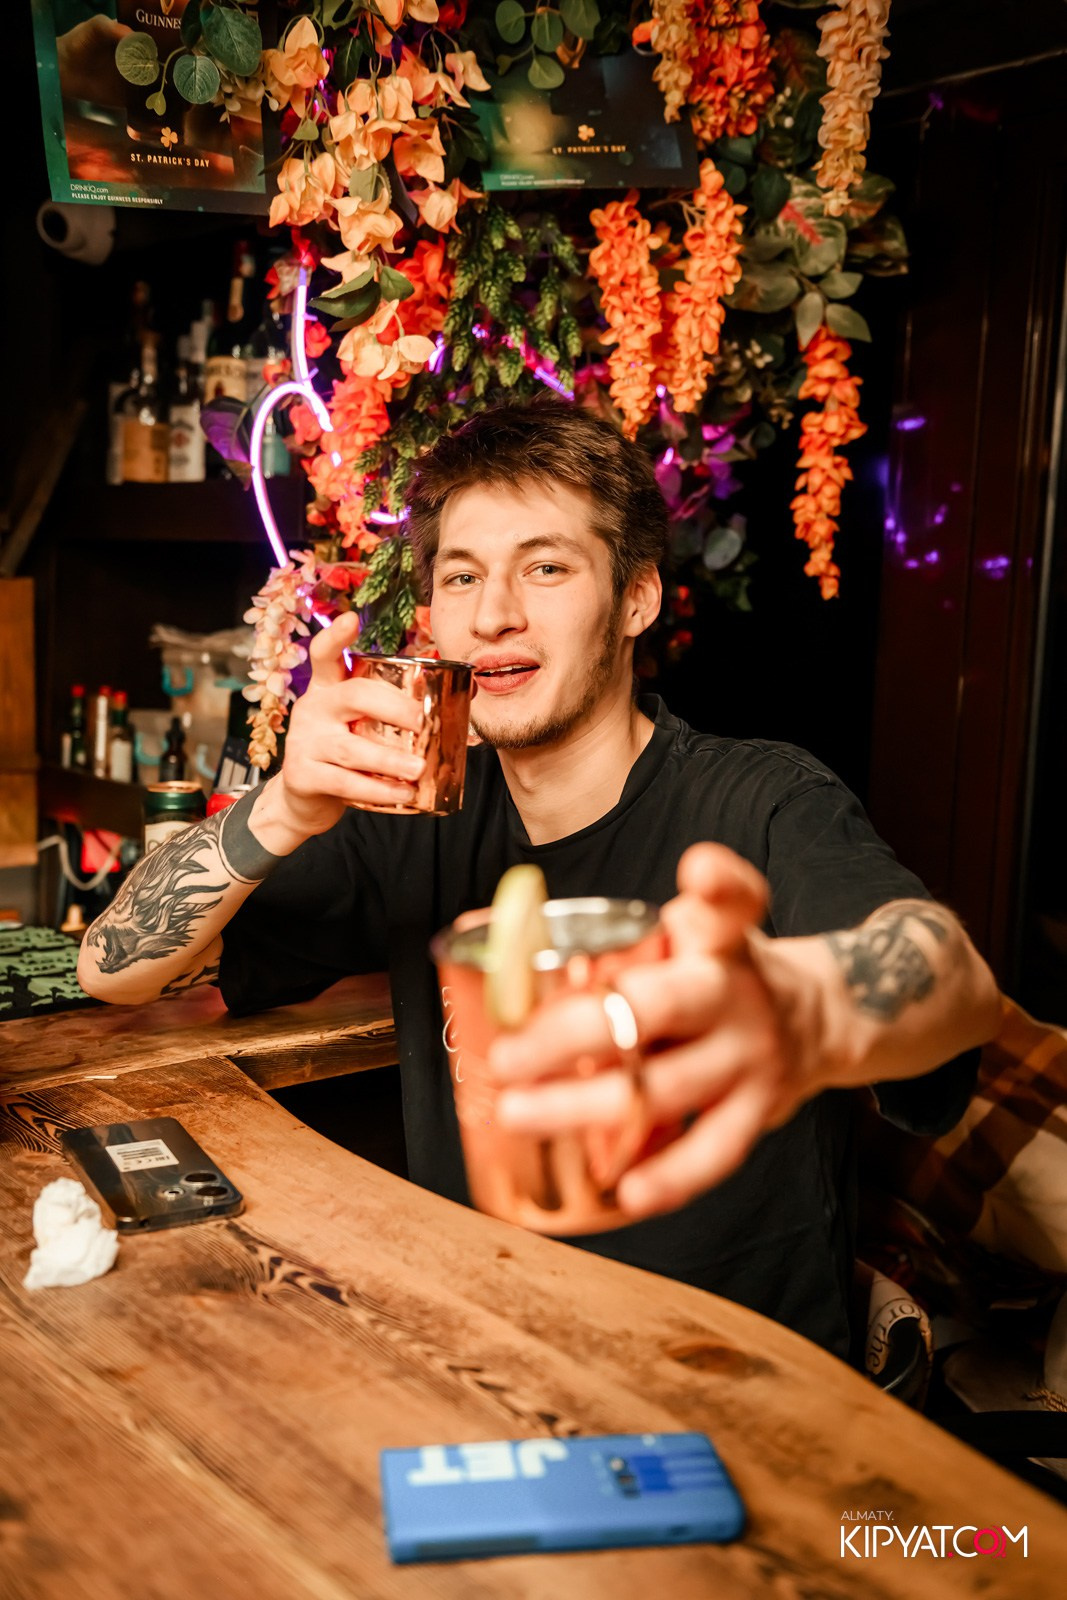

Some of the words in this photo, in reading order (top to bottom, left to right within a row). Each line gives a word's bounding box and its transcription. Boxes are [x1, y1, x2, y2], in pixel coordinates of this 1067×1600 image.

[136, 9, 181, 30] GUINNES
[130, 153, 144, 163] ST.
[147, 154, 191, 166] PATRICK'S
[194, 158, 210, 168] DAY
[90, 193, 107, 201] ENJOY
[107, 195, 132, 203] GUINNESS
[131, 197, 163, 205] RESPONSIBLY
[408, 1438, 569, 1487] JET
